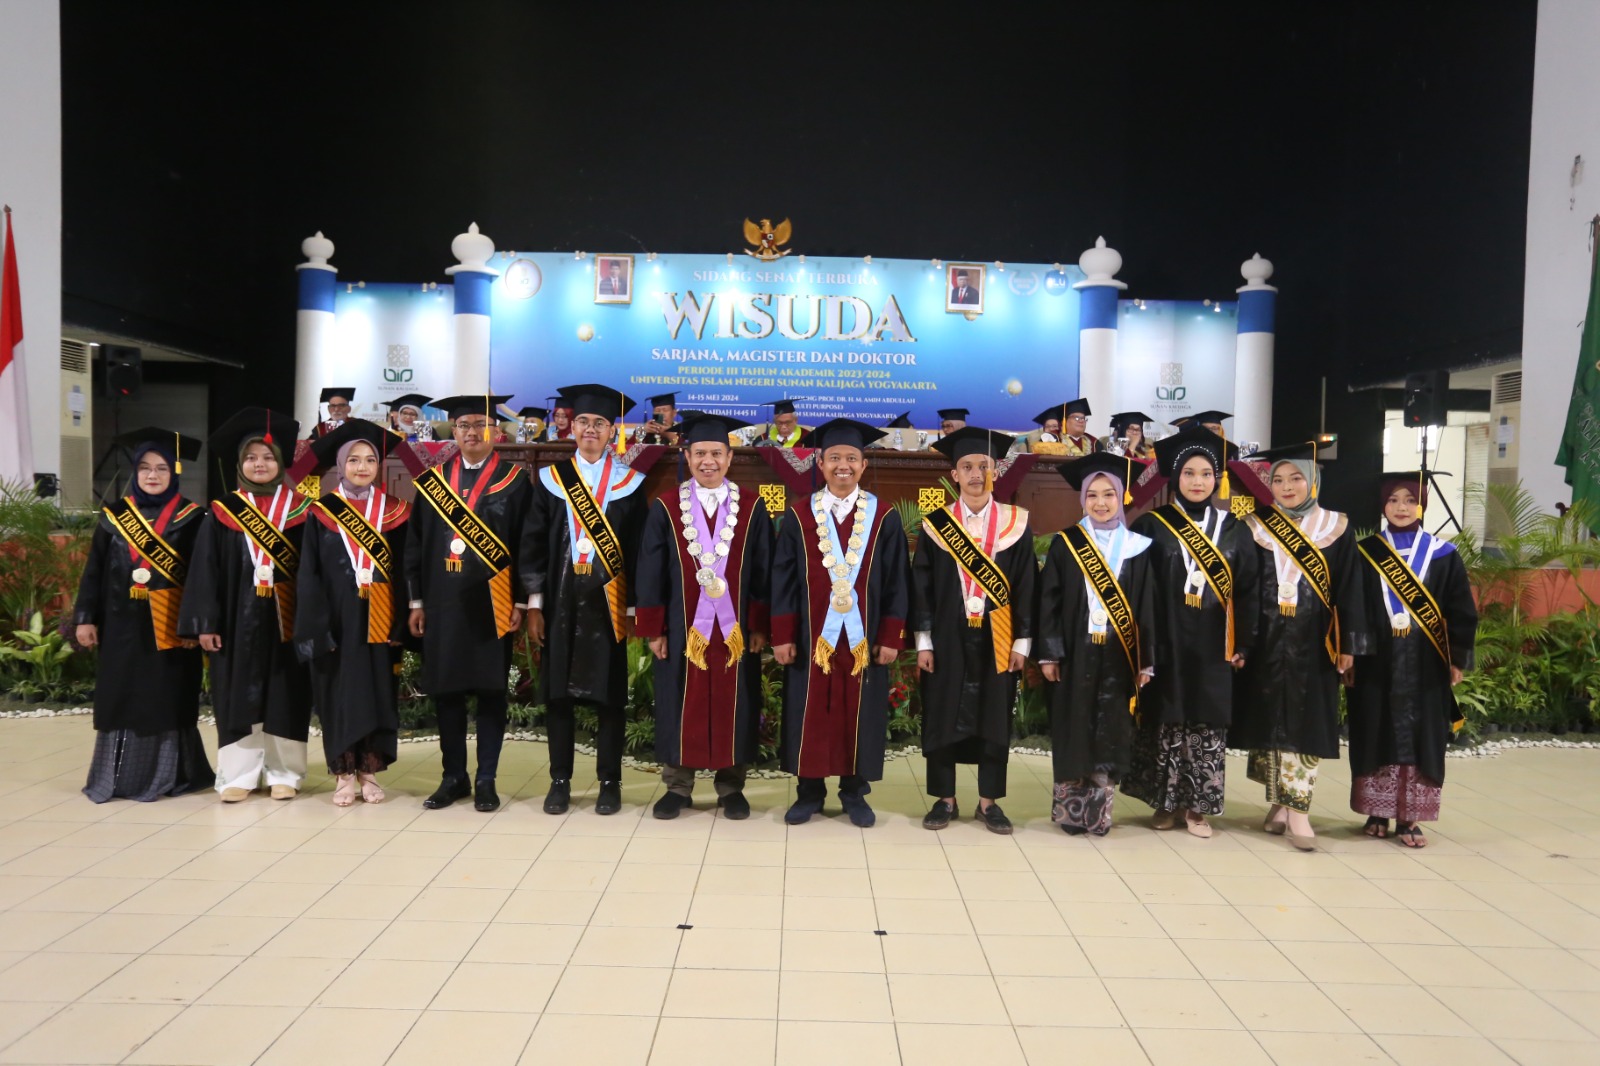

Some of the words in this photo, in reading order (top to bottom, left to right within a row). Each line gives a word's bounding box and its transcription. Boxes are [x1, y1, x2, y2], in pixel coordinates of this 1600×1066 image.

[693, 270, 752, 283] SIDANG
[755, 271, 802, 284] SENAT
[808, 272, 879, 286] TERBUKA
[655, 290, 918, 342] WISUDA
[651, 348, 724, 363] SARJANA,
[726, 350, 807, 363] MAGISTER
[810, 351, 843, 364] DAN
[847, 352, 917, 366] DOKTOR
[678, 366, 724, 375] PERIODE
[726, 366, 738, 375] III
[741, 367, 777, 377] TAHUN
[779, 368, 835, 378] AKADEMIK
[837, 369, 891, 379] 2023/2024
[630, 375, 699, 385] UNIVERSITAS
[701, 377, 733, 386] ISLAM
[735, 377, 775, 387] NEGERI
[776, 378, 814, 388] SUNAN
[816, 379, 866, 390] KALIJAGA
[867, 380, 938, 391] YOGYAKARTA
[721, 394, 739, 402] 2024
[750, 409, 757, 417] H
[117, 509, 153, 550] TERBAIK
[237, 506, 281, 550] TERBAIK
[338, 507, 381, 551] TERBAIK
[423, 476, 460, 516] TERBAIK
[457, 513, 505, 562] TERCEPAT
[568, 482, 602, 530] TERBAIK
[595, 528, 623, 575] TERCEP
[1265, 512, 1306, 553] TERBAIK
[940, 521, 979, 567] TERBAIK
[1179, 523, 1219, 569] TERBAIK
[1078, 543, 1114, 594] TERBAIK
[1380, 555, 1422, 604] TERBAIK
